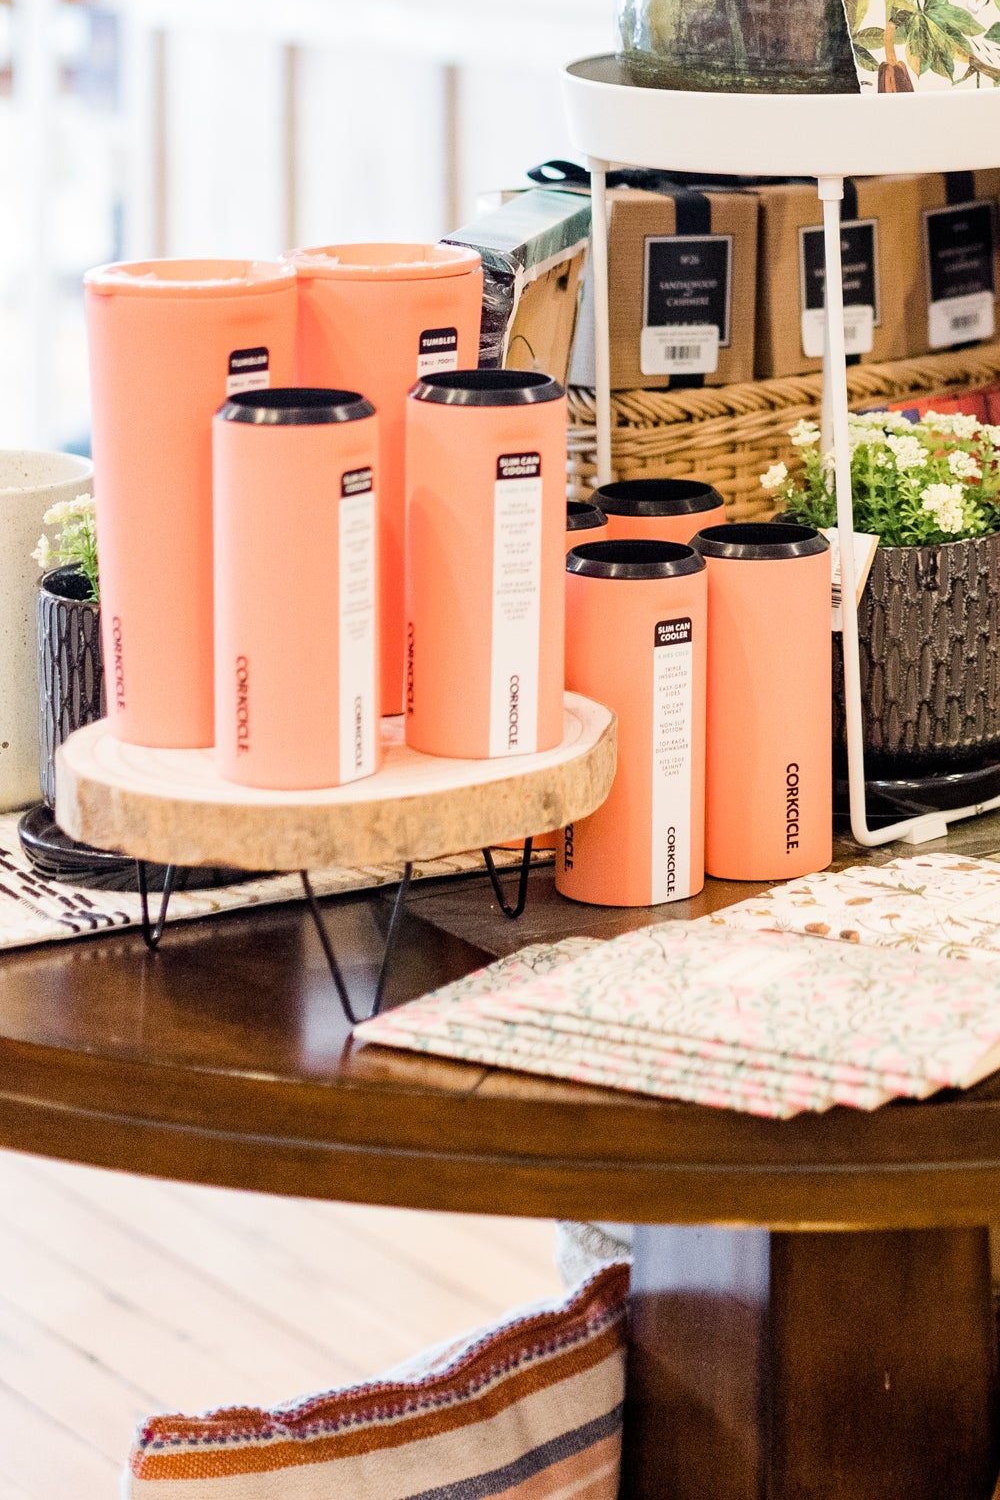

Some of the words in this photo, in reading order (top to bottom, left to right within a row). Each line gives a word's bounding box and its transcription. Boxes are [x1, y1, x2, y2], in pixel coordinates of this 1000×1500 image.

[422, 336, 456, 347] TUMBLER
[502, 465, 537, 476] COOLER
[658, 624, 674, 635] SLIM
[675, 622, 690, 631] CAN
[660, 631, 688, 642] COOLER
[786, 762, 800, 855] CORKCICLE.
[667, 826, 676, 897] CORKCICLE.
